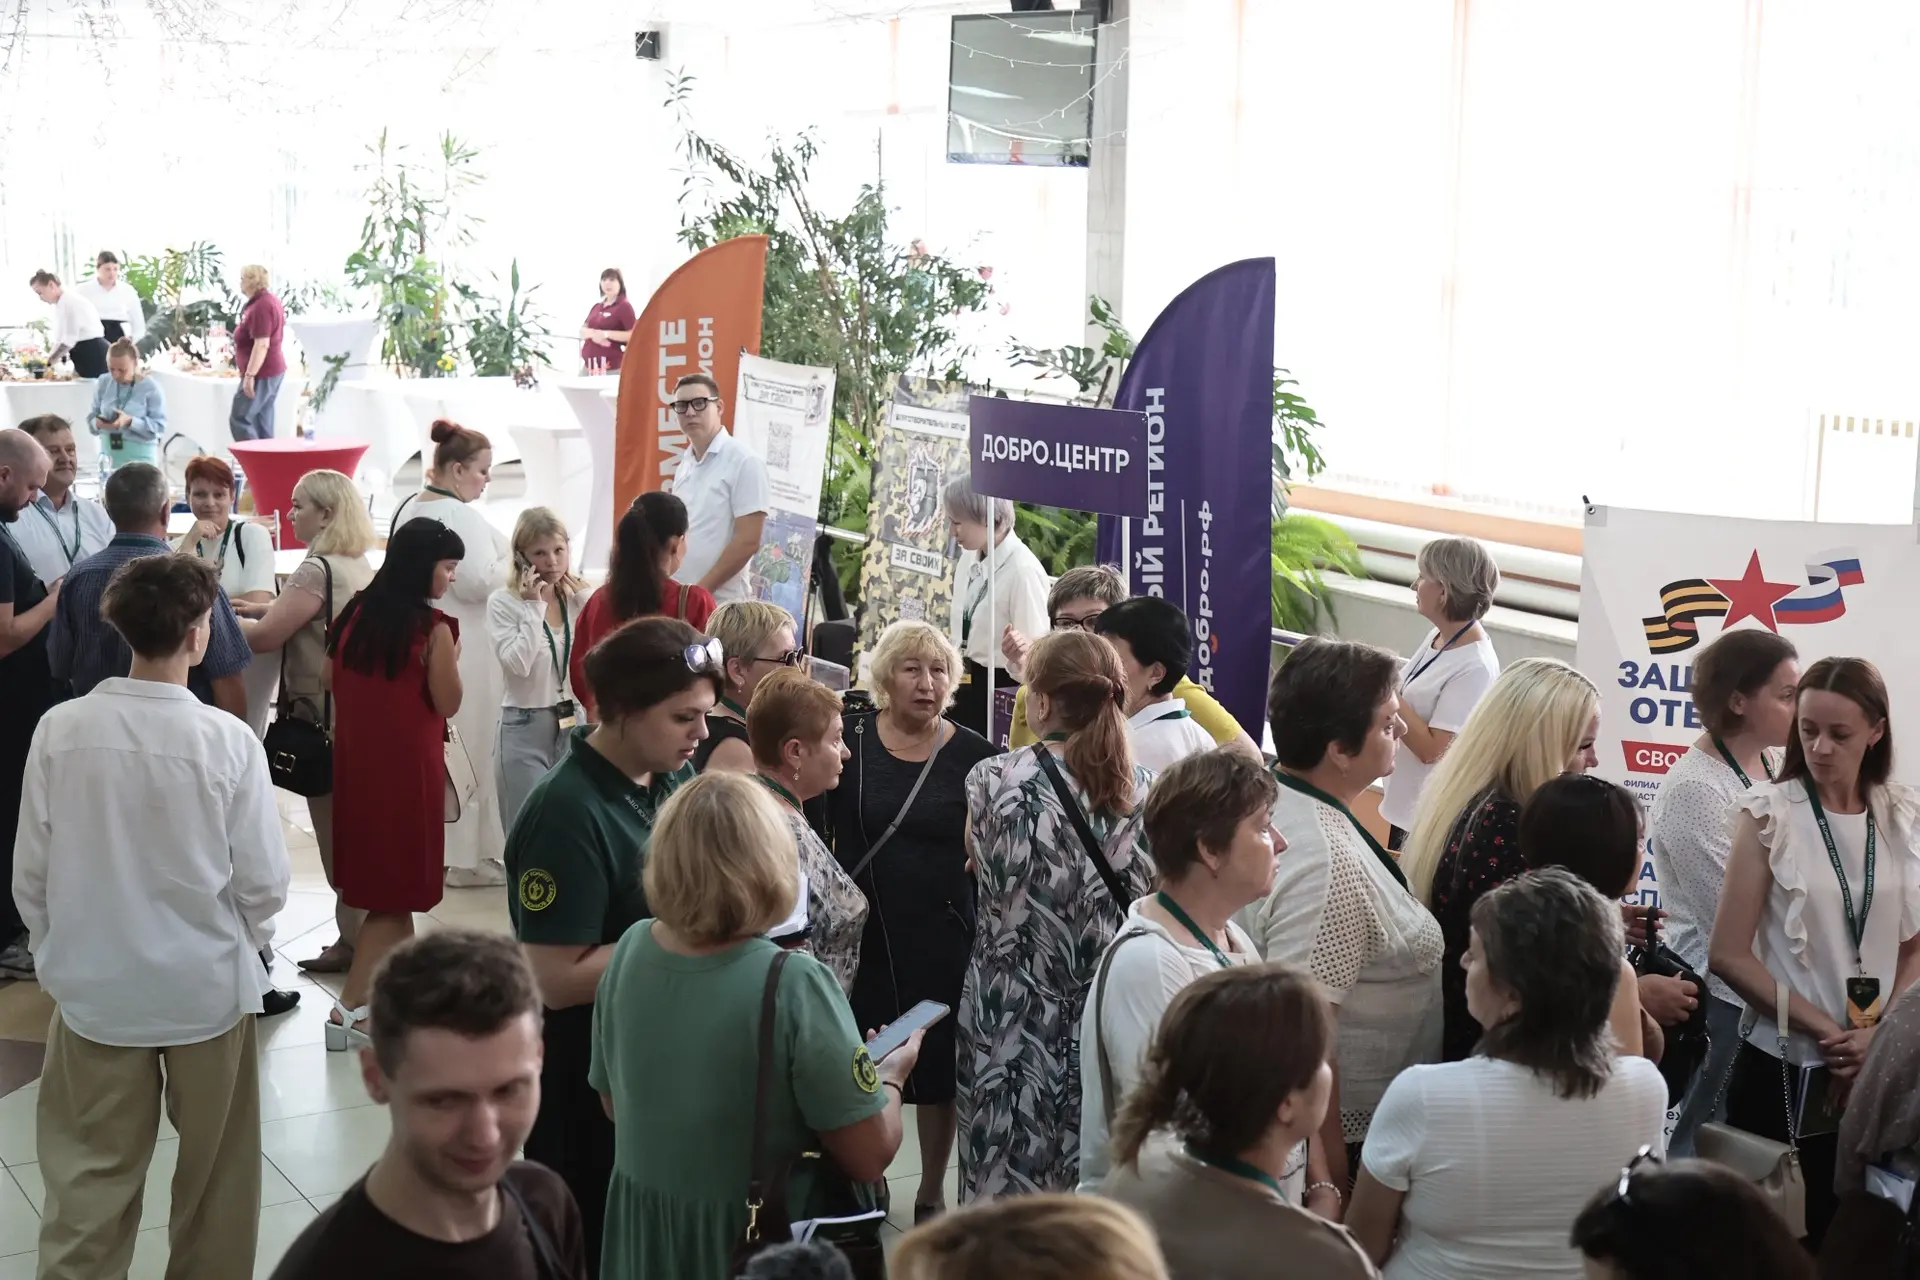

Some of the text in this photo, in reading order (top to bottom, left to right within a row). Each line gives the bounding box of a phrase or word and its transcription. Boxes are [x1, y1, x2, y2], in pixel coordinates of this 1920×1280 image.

[981, 433, 1130, 474] ДОБРО.ЦЕНТР
[894, 548, 940, 571] ЗА СВОИХ
[1195, 500, 1215, 693] добро.рф
[1635, 749, 1686, 768] СВО
